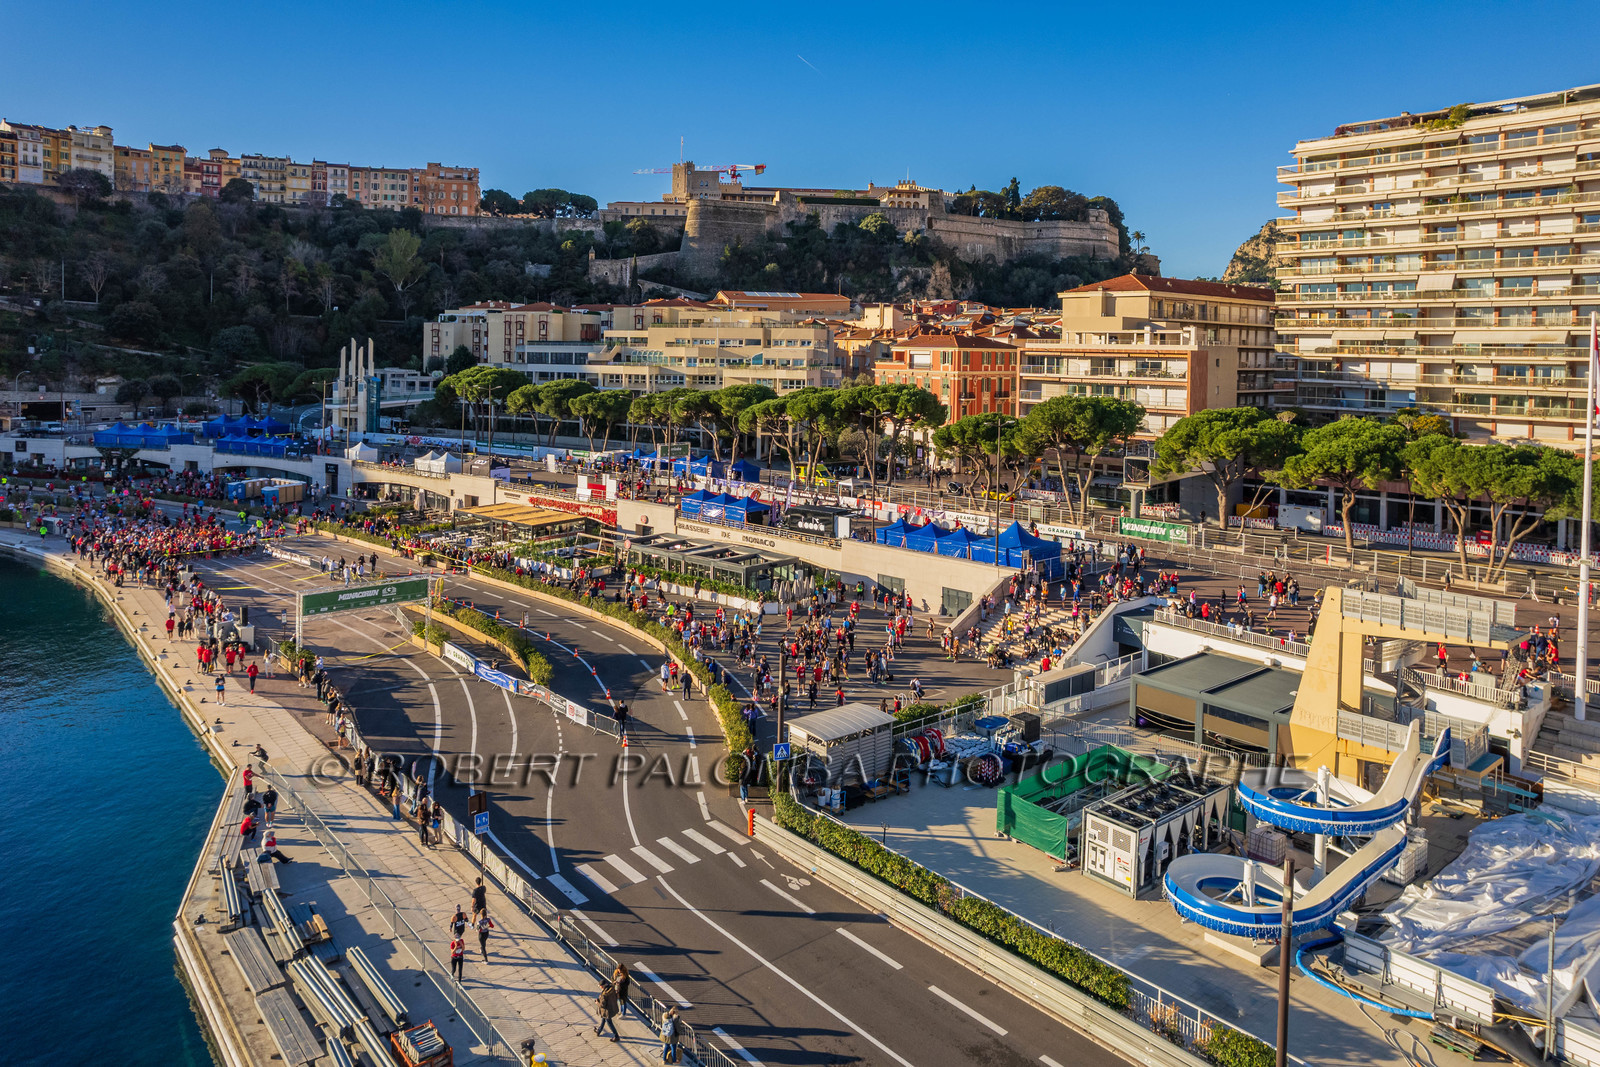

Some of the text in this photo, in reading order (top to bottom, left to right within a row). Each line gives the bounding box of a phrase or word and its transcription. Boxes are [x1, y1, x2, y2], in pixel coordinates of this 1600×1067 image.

[677, 522, 776, 548] BRASSERIE DE MONACO
